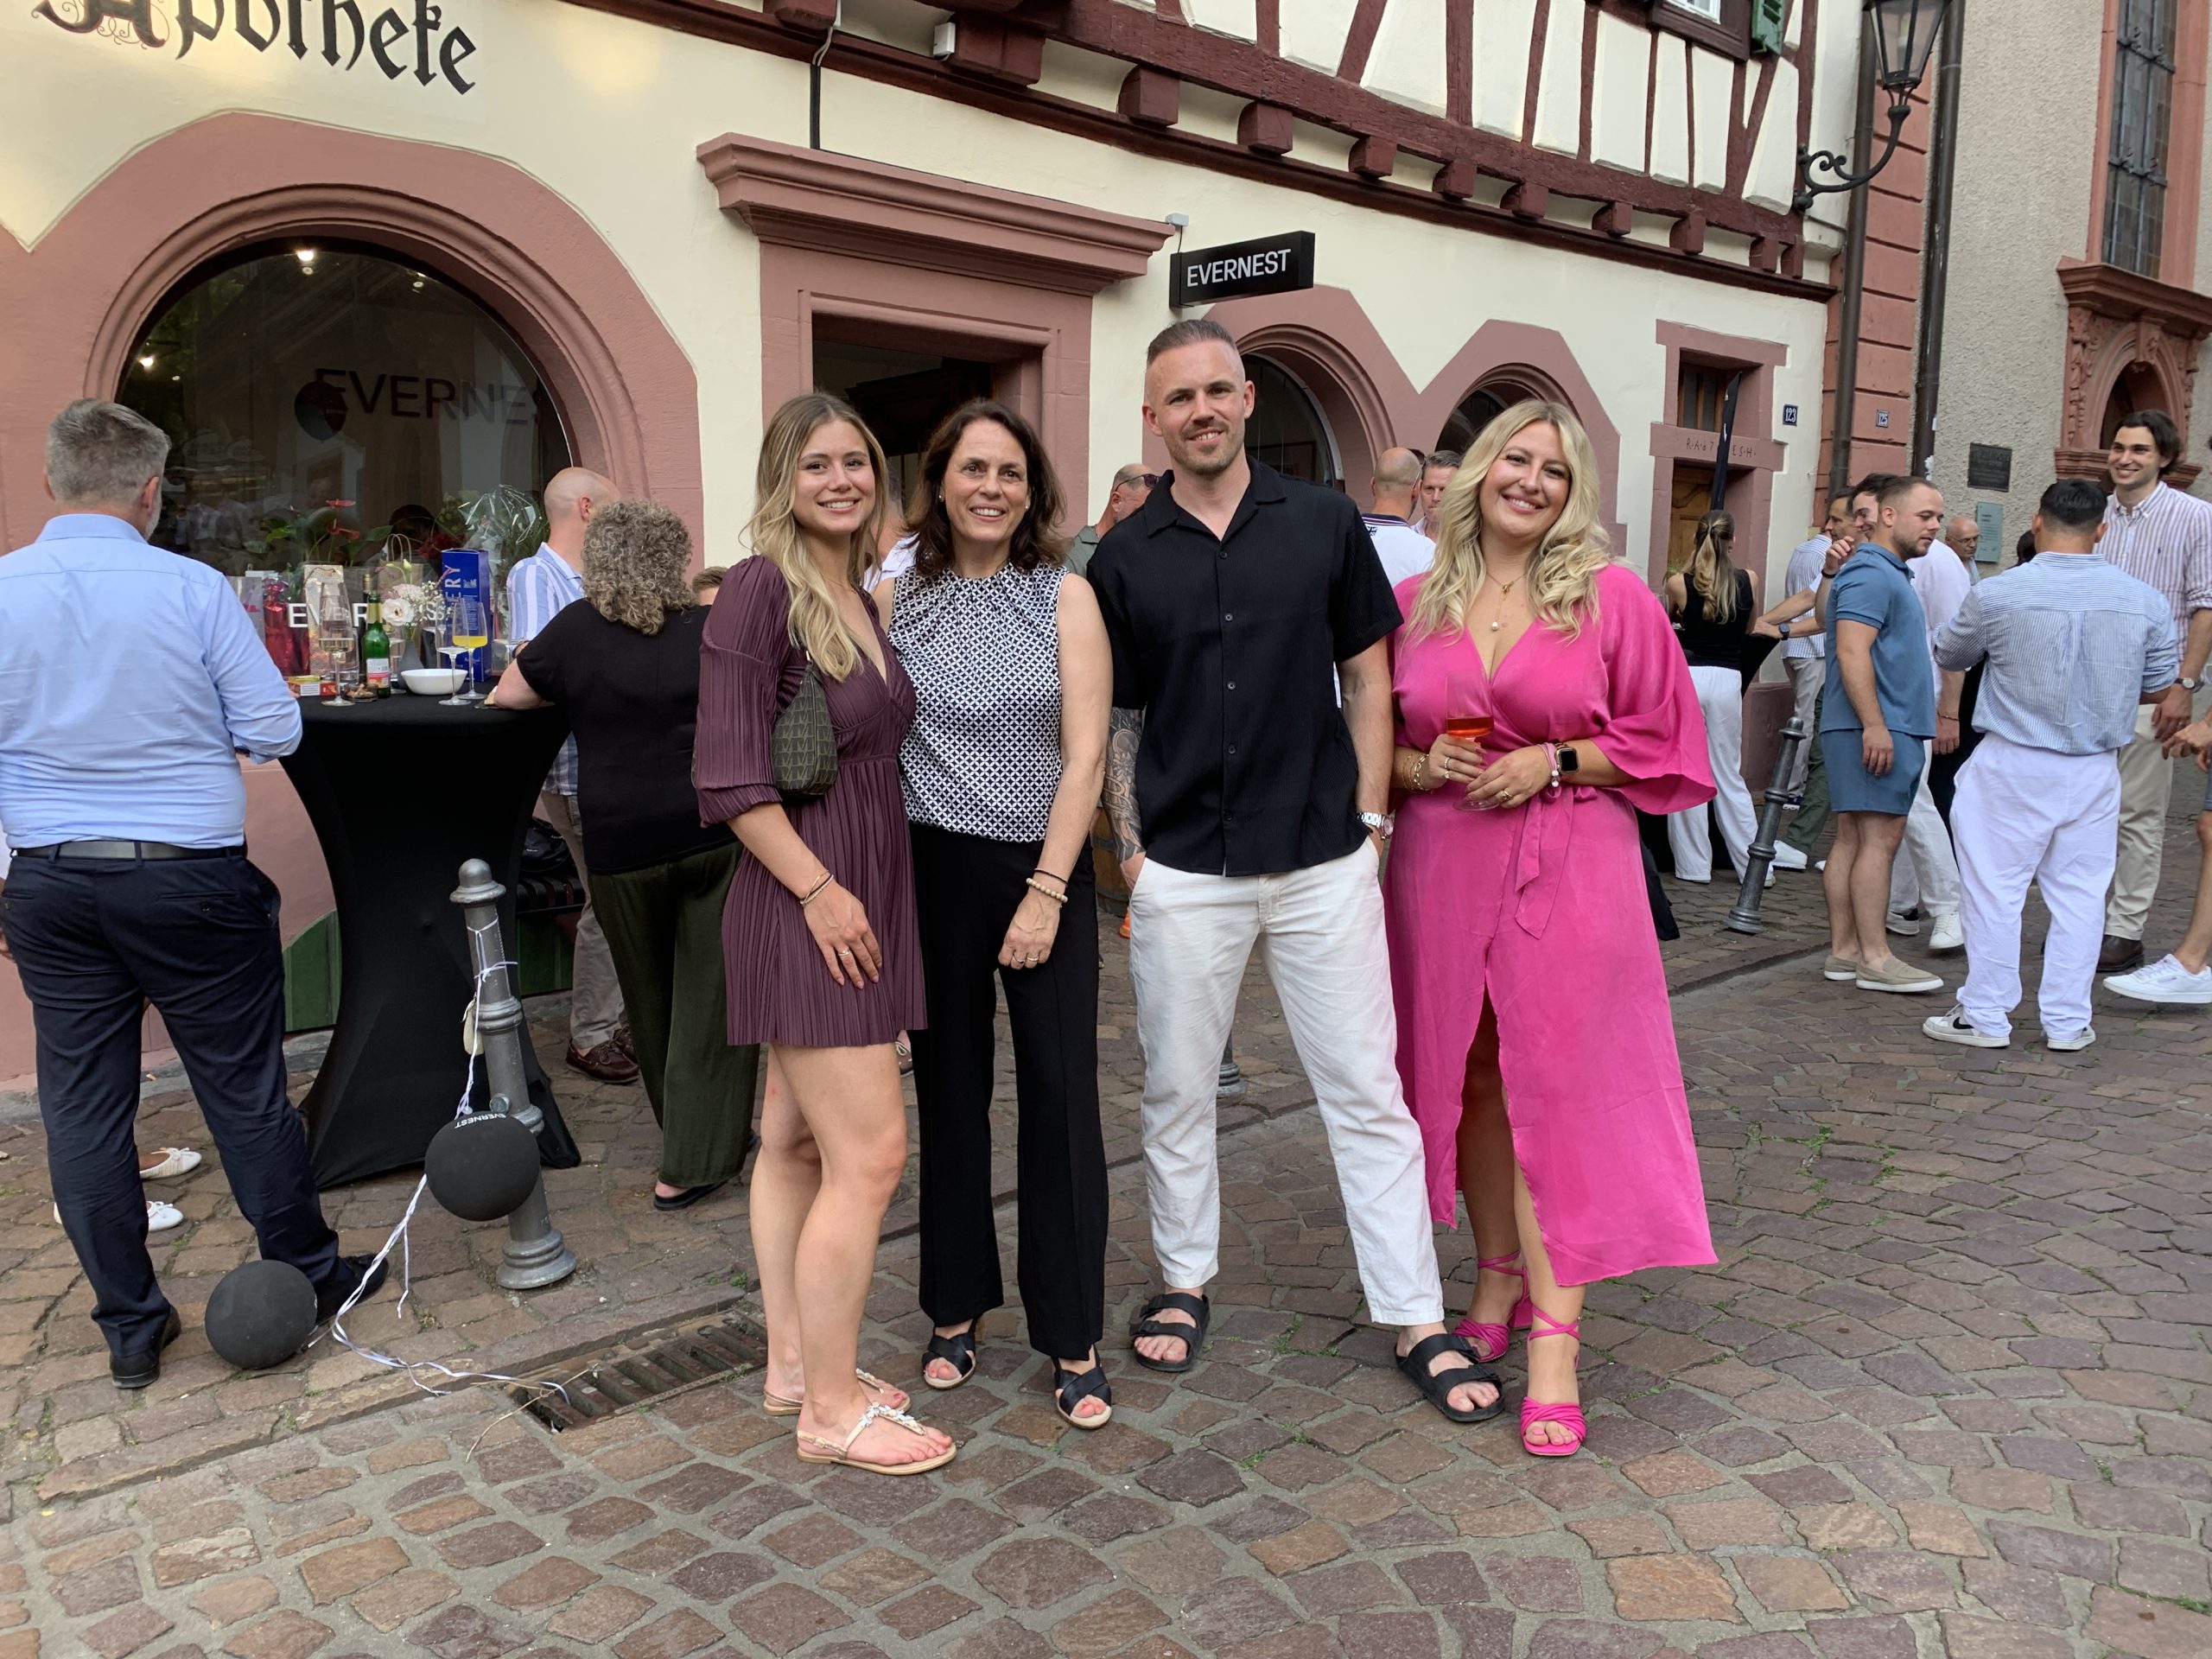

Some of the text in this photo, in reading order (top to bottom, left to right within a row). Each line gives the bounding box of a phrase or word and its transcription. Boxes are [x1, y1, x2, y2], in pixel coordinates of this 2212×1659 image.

[1187, 249, 1291, 287] EVERNEST
[1785, 407, 1796, 423] 123
[454, 1113, 506, 1128] EVERNEST
